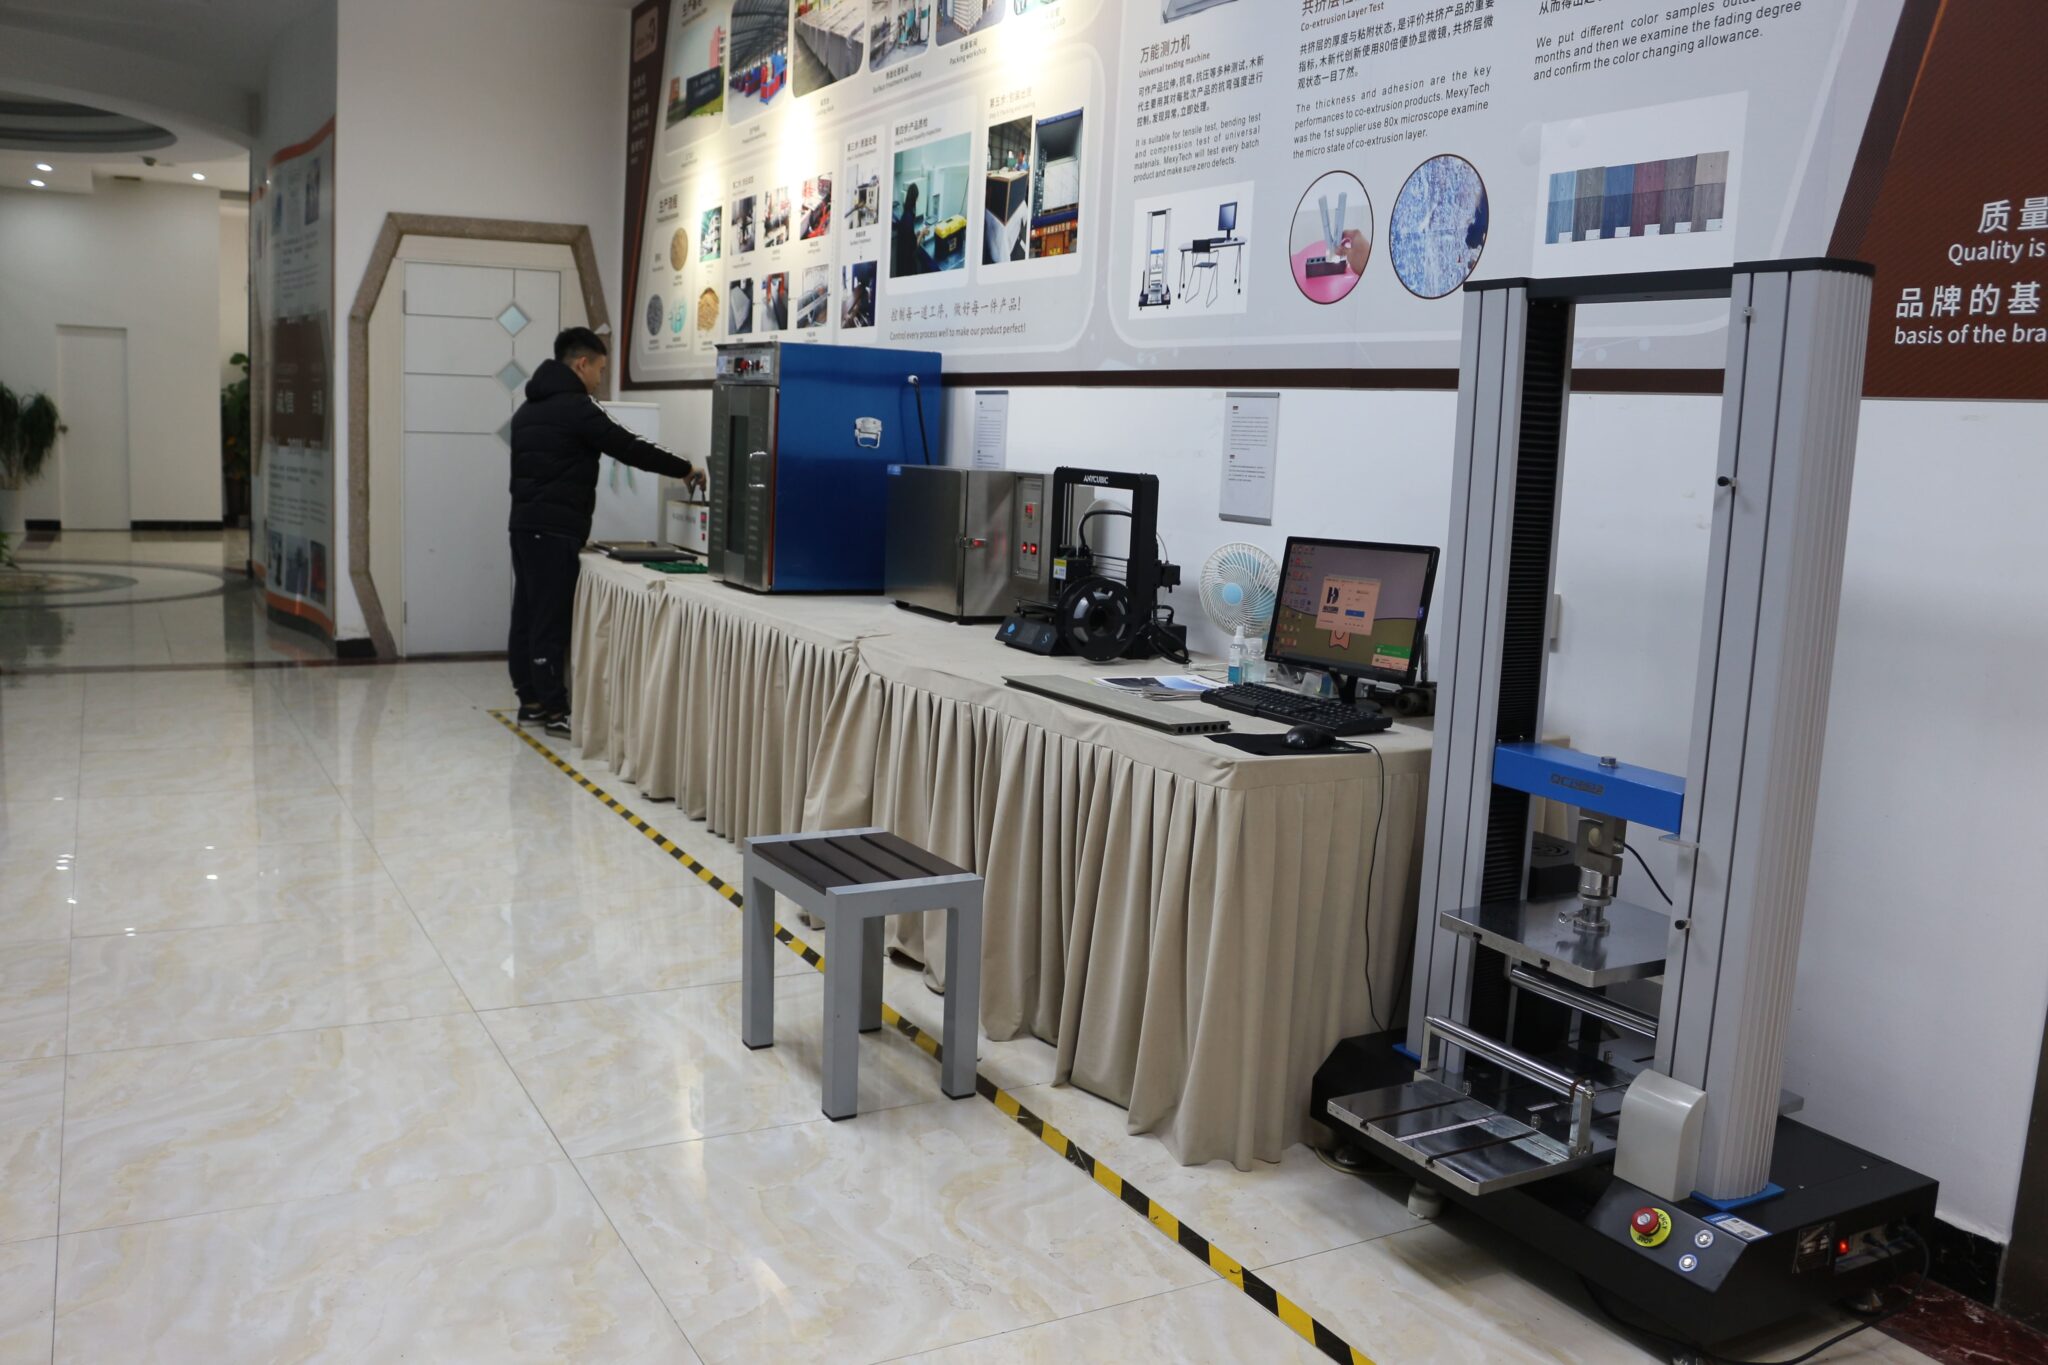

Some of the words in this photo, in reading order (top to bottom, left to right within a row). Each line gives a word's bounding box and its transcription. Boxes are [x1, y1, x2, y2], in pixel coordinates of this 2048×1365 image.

[1301, 13, 1345, 31] Co-extrusion
[1348, 6, 1367, 19] Layer
[1369, 2, 1384, 13] Test
[1535, 49, 1570, 64] months
[1574, 43, 1593, 56] and
[1596, 40, 1619, 52] then
[1622, 36, 1637, 46] we
[1641, 25, 1688, 42] examine
[1692, 20, 1710, 32] the
[1714, 11, 1752, 28] fading
[1756, 1, 1802, 19] degree
[1536, 37, 1551, 48] We
[1558, 32, 1574, 46] put
[1581, 20, 1624, 39] different
[1631, 14, 1659, 28] color
[1665, 1, 1714, 21] samples
[1140, 34, 1190, 63] 万能测力机
[1533, 67, 1552, 80] and
[1554, 61, 1591, 77] confirm
[1594, 57, 1610, 69] the
[1613, 51, 1641, 65] color
[1642, 41, 1694, 59] changing
[1698, 28, 1763, 49] allowance.
[1139, 63, 1164, 78] Universal
[1165, 59, 1184, 71] testing
[1186, 52, 1210, 65] machine
[1296, 104, 1310, 113] The
[1316, 94, 1356, 110] thickness
[1361, 89, 1376, 100] and
[1382, 80, 1424, 96] adhesion
[1430, 75, 1445, 86] are
[1452, 70, 1467, 81] the
[1474, 65, 1491, 77] key
[1294, 135, 1308, 144] was
[1309, 131, 1321, 141] the
[1324, 129, 1335, 138] 1st
[1336, 122, 1366, 136] supplier
[1368, 121, 1381, 131] use
[1384, 117, 1398, 128] 80x
[1401, 108, 1448, 125] microscope
[1451, 100, 1488, 115] examine
[1295, 112, 1344, 130] performances
[1346, 110, 1353, 119] to
[1355, 100, 1402, 117] co-extrusion
[1405, 93, 1442, 110] products.
[1446, 82, 1489, 99] MexyTech
[1135, 149, 1146, 159] and
[1150, 141, 1192, 156] compression
[1197, 136, 1209, 146] test
[1214, 133, 1221, 142] of
[1225, 125, 1260, 140] universal
[1149, 131, 1170, 144] suitable
[1172, 130, 1181, 139] for
[1182, 125, 1202, 136] tensile
[1221, 115, 1245, 128] bending
[1249, 112, 1260, 123] test
[1293, 149, 1304, 159] the
[1305, 145, 1325, 157] micro
[1327, 142, 1345, 153] state
[1347, 140, 1354, 150] of
[1356, 131, 1403, 148] co-extrusion
[1406, 129, 1427, 142] layer.
[1163, 151, 1192, 165] MexyTech
[1195, 149, 1204, 158] will
[1207, 146, 1218, 156] test
[1221, 143, 1238, 154] every
[1241, 139, 1259, 150] batch
[1133, 170, 1155, 183] product
[1155, 168, 1165, 178] and
[1167, 164, 1182, 175] make
[1184, 164, 1196, 173] sure
[1197, 161, 1210, 170] zero
[1212, 156, 1237, 168] defects.
[1977, 196, 2048, 234] 质量
[1948, 240, 2023, 266] Quality
[2028, 237, 2047, 258] is
[1895, 281, 2041, 318] 品牌的基
[890, 331, 906, 341] Control
[907, 331, 919, 341] every
[920, 330, 937, 340] process
[956, 328, 969, 336] make
[970, 328, 980, 336] our
[980, 325, 1002, 337] product
[1894, 325, 1943, 345] basis
[1948, 324, 1969, 344] of
[1973, 324, 2006, 344] the
